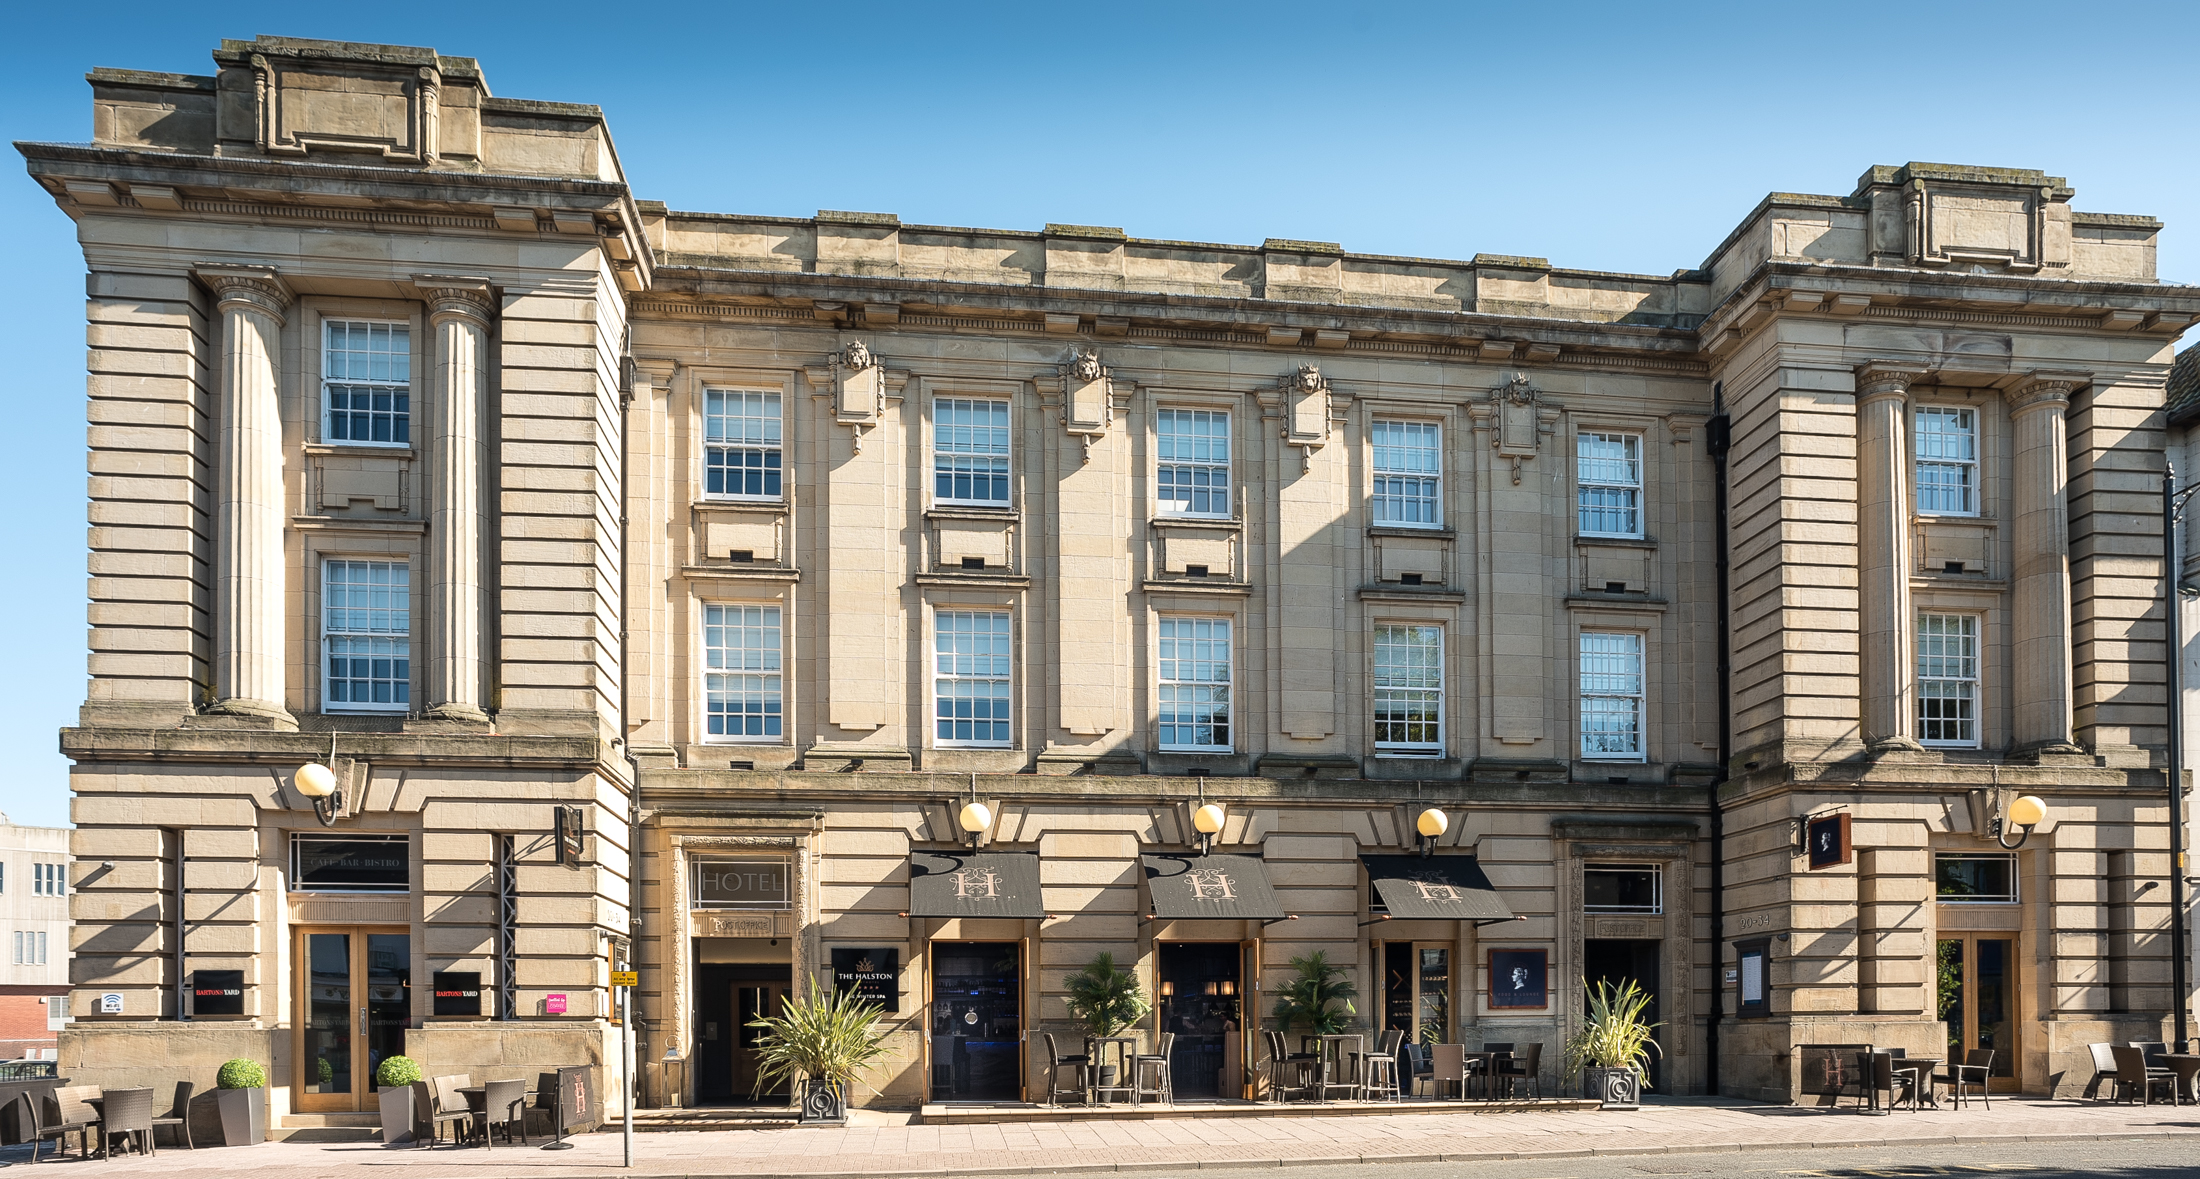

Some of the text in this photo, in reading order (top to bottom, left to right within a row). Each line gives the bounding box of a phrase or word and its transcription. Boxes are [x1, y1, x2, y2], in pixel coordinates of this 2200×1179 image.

[341, 859, 360, 867] BAR
[365, 859, 400, 867] BISTRO
[702, 872, 783, 892] HOTEL
[715, 920, 769, 931] POST OFFICE
[1740, 914, 1770, 929] 20-34
